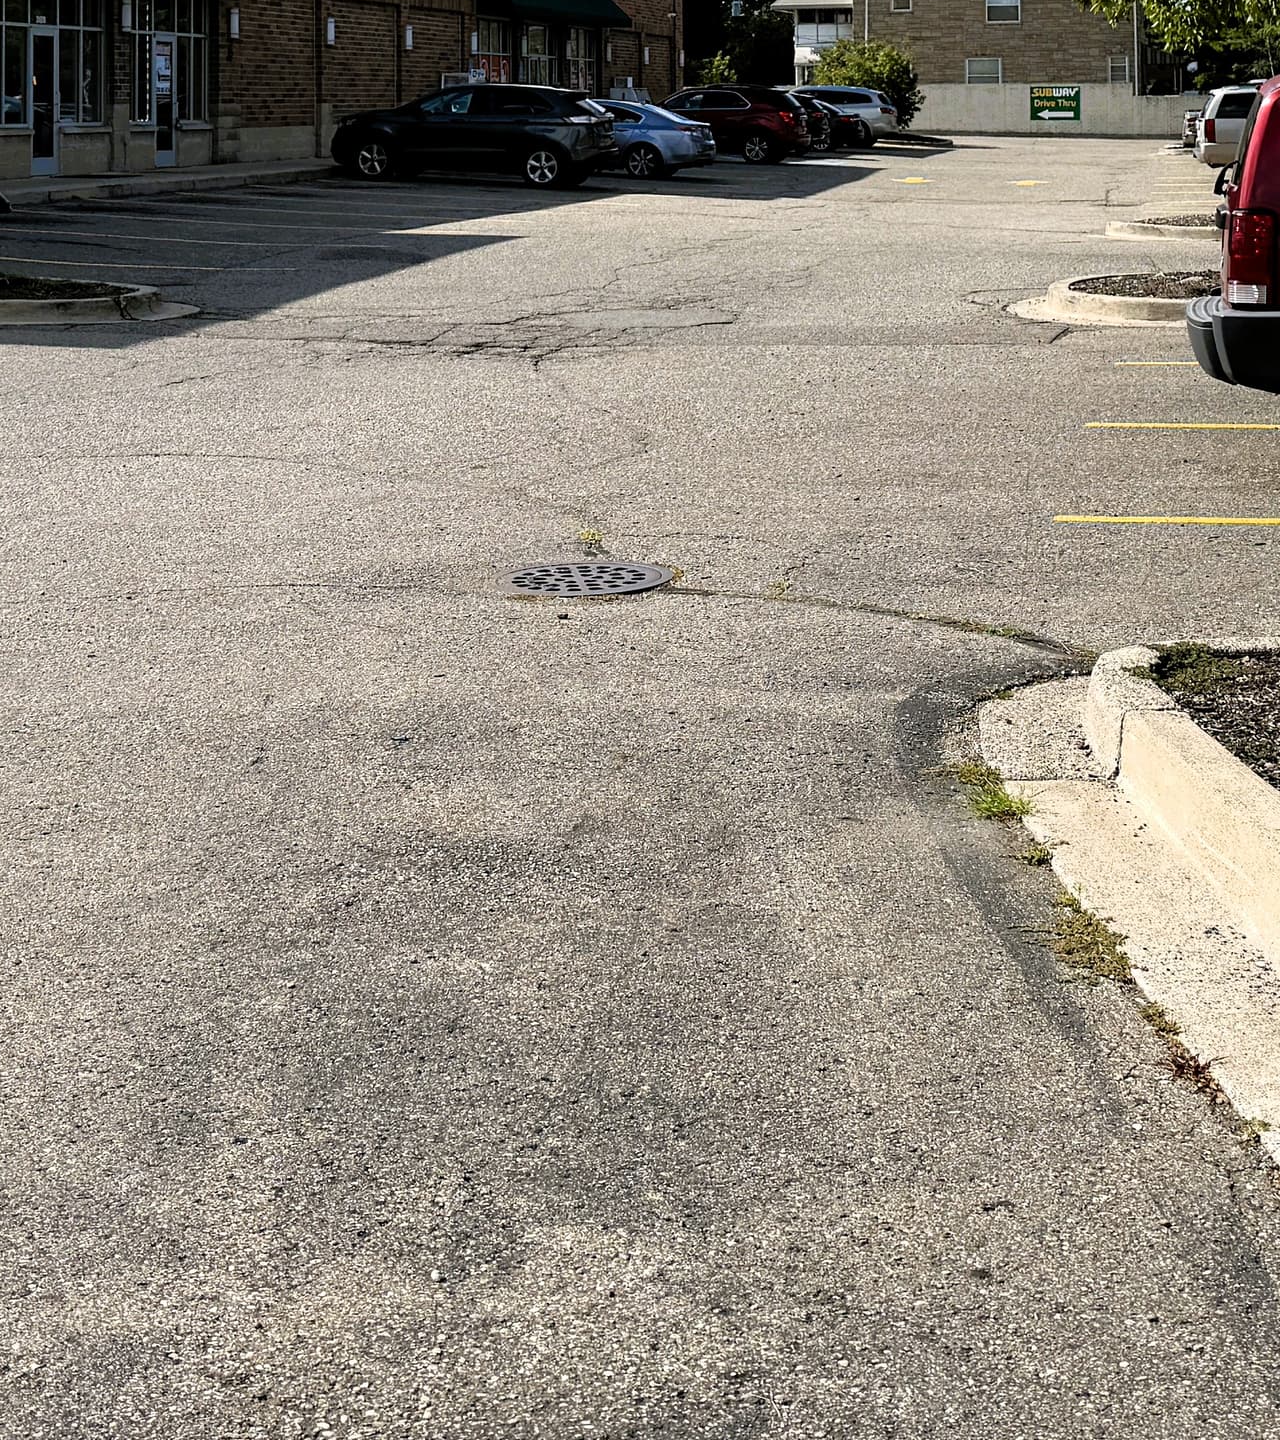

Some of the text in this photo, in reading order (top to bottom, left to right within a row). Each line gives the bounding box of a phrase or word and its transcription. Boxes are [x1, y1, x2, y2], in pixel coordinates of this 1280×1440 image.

[1031, 87, 1079, 97] SUBWAY
[1034, 99, 1076, 107] Drive Thru
